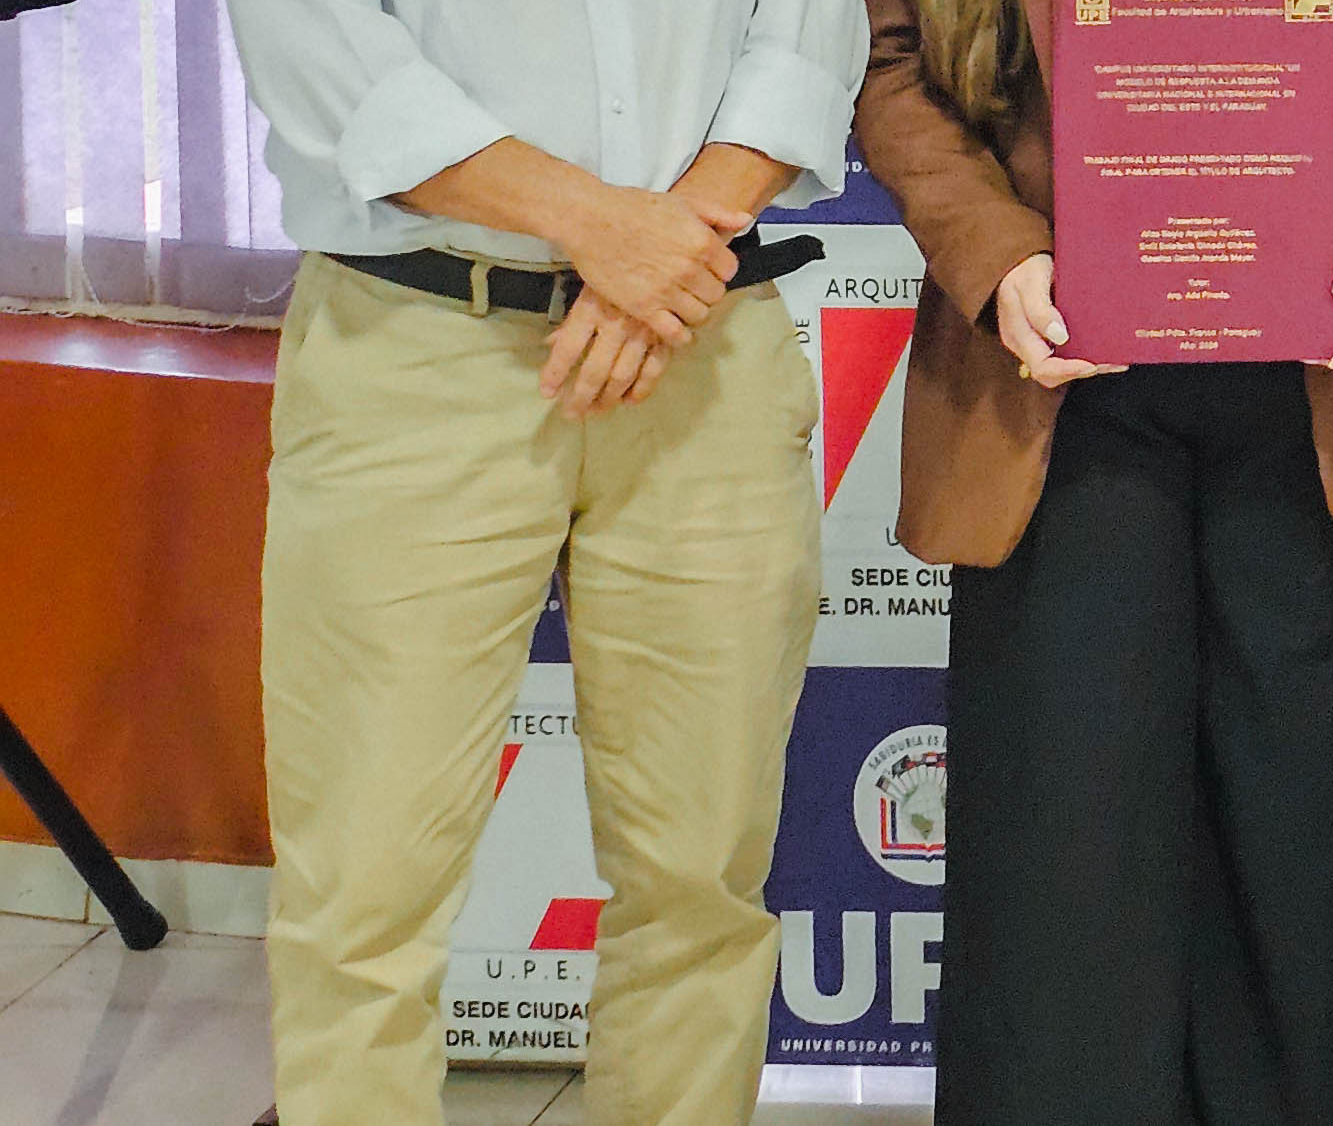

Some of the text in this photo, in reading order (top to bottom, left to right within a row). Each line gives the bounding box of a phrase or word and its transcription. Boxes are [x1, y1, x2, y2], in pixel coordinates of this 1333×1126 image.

[825, 278, 924, 303] ARQUIT
[851, 569, 952, 587] SEDE CIU
[844, 598, 880, 615] DR.
[888, 598, 951, 615] MANU
[453, 1001, 510, 1018] SEDE
[446, 1030, 579, 1048] DR. MANUEL
[781, 1039, 901, 1052] UNIVERSIDAD
